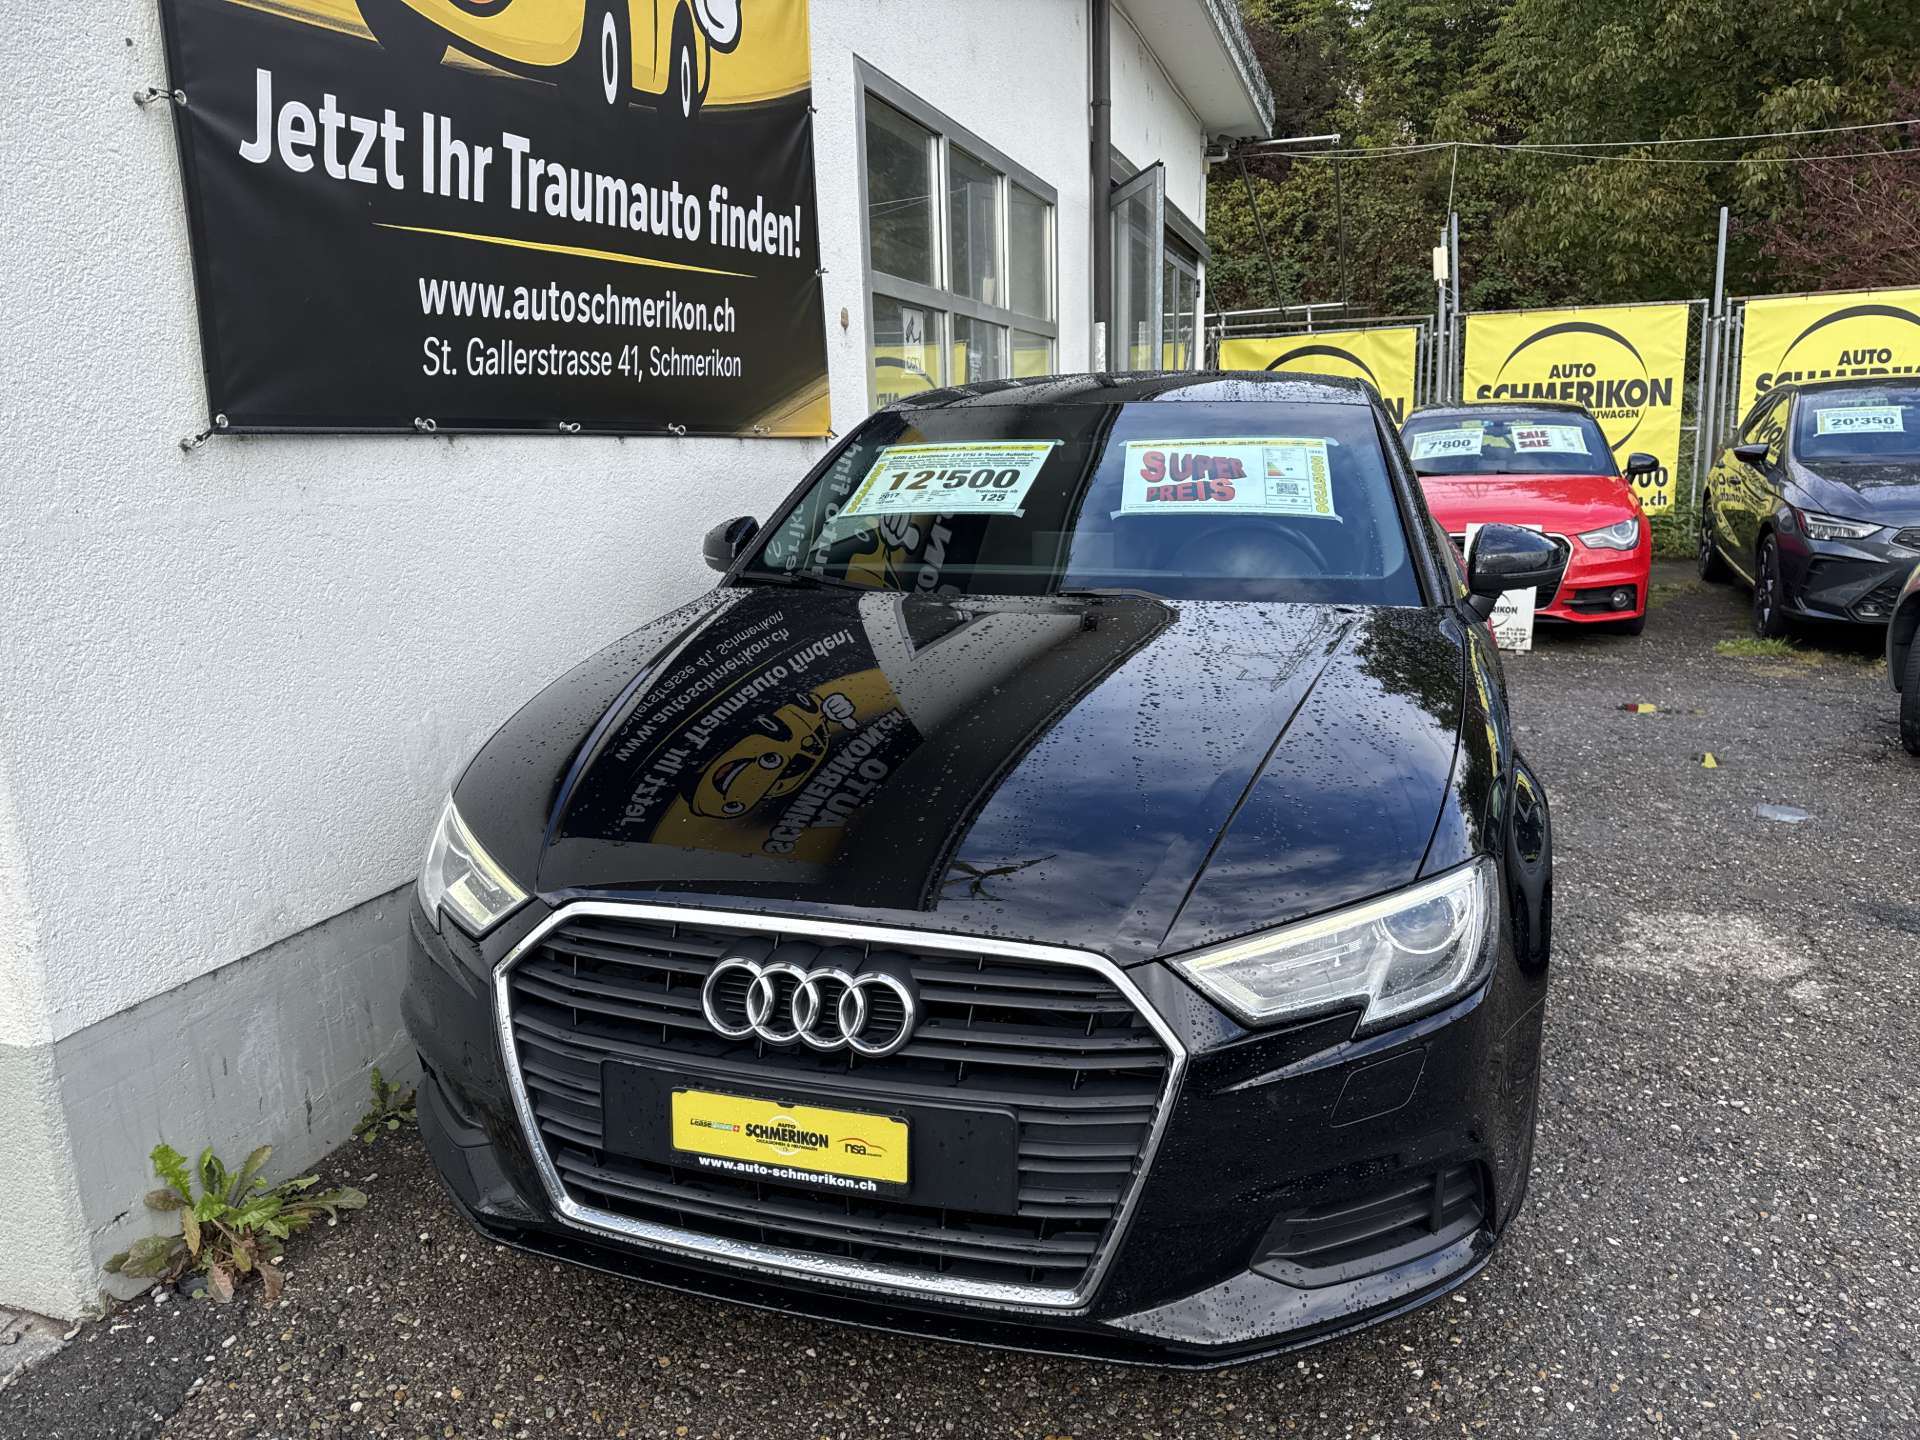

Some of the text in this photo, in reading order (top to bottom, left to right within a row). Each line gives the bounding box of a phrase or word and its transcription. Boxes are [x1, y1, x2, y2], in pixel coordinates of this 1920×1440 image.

[238, 67, 801, 259] Jetzt Ihr Traumauto finden!
[419, 276, 735, 333] www.autoschmerikon.ch
[422, 335, 742, 384] St. Gallerstrasse 41, Schmerikon
[1838, 348, 1892, 366] AUTO
[1549, 363, 1596, 379] AUTO
[1594, 409, 1639, 419] UWAGEN
[1831, 417, 1895, 426] 20'350
[1517, 430, 1549, 439] SALE
[1518, 439, 1551, 448] SALE
[1429, 439, 1471, 450] 7'800
[1140, 451, 1248, 483] SUPER
[889, 469, 1020, 491] 12'500
[980, 494, 1007, 502] 125
[1145, 478, 1236, 502] PREIS
[745, 1123, 829, 1149] SCHMERIKON
[844, 1143, 867, 1155] nsa
[698, 1156, 877, 1192] www.auto-schmerikon.ch
